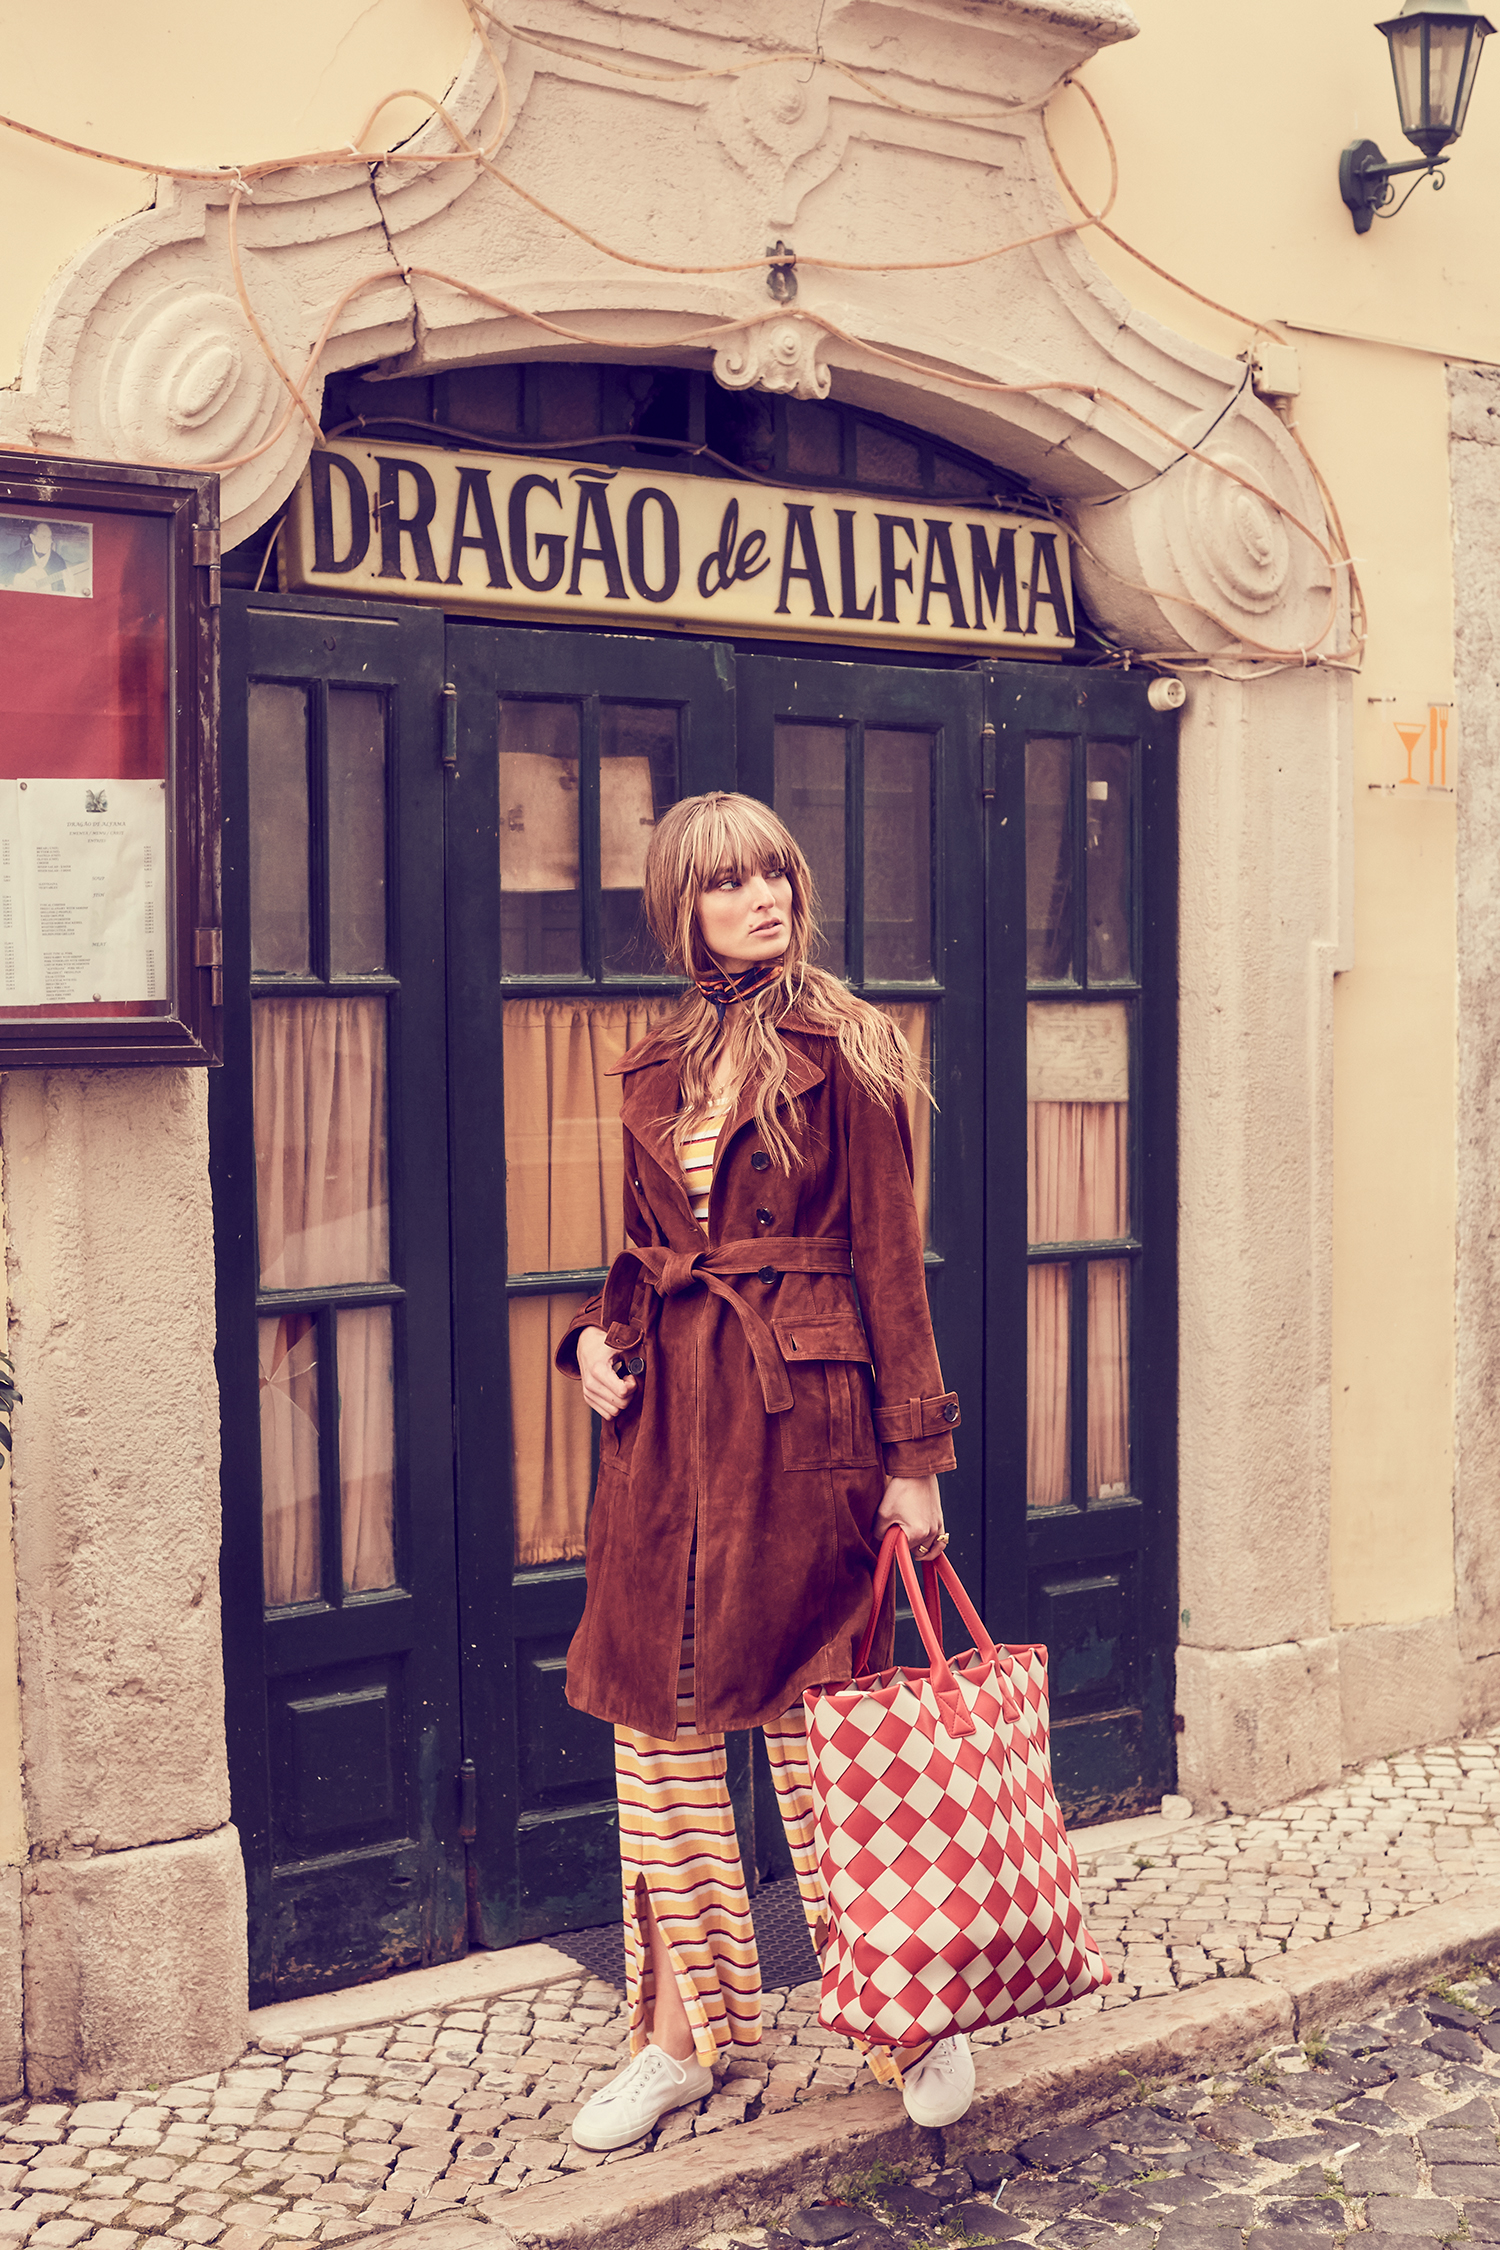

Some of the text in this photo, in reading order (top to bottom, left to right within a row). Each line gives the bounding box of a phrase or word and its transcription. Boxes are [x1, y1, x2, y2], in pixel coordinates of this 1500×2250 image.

[311, 449, 1075, 639] DRAGÃO de ALFAMA
